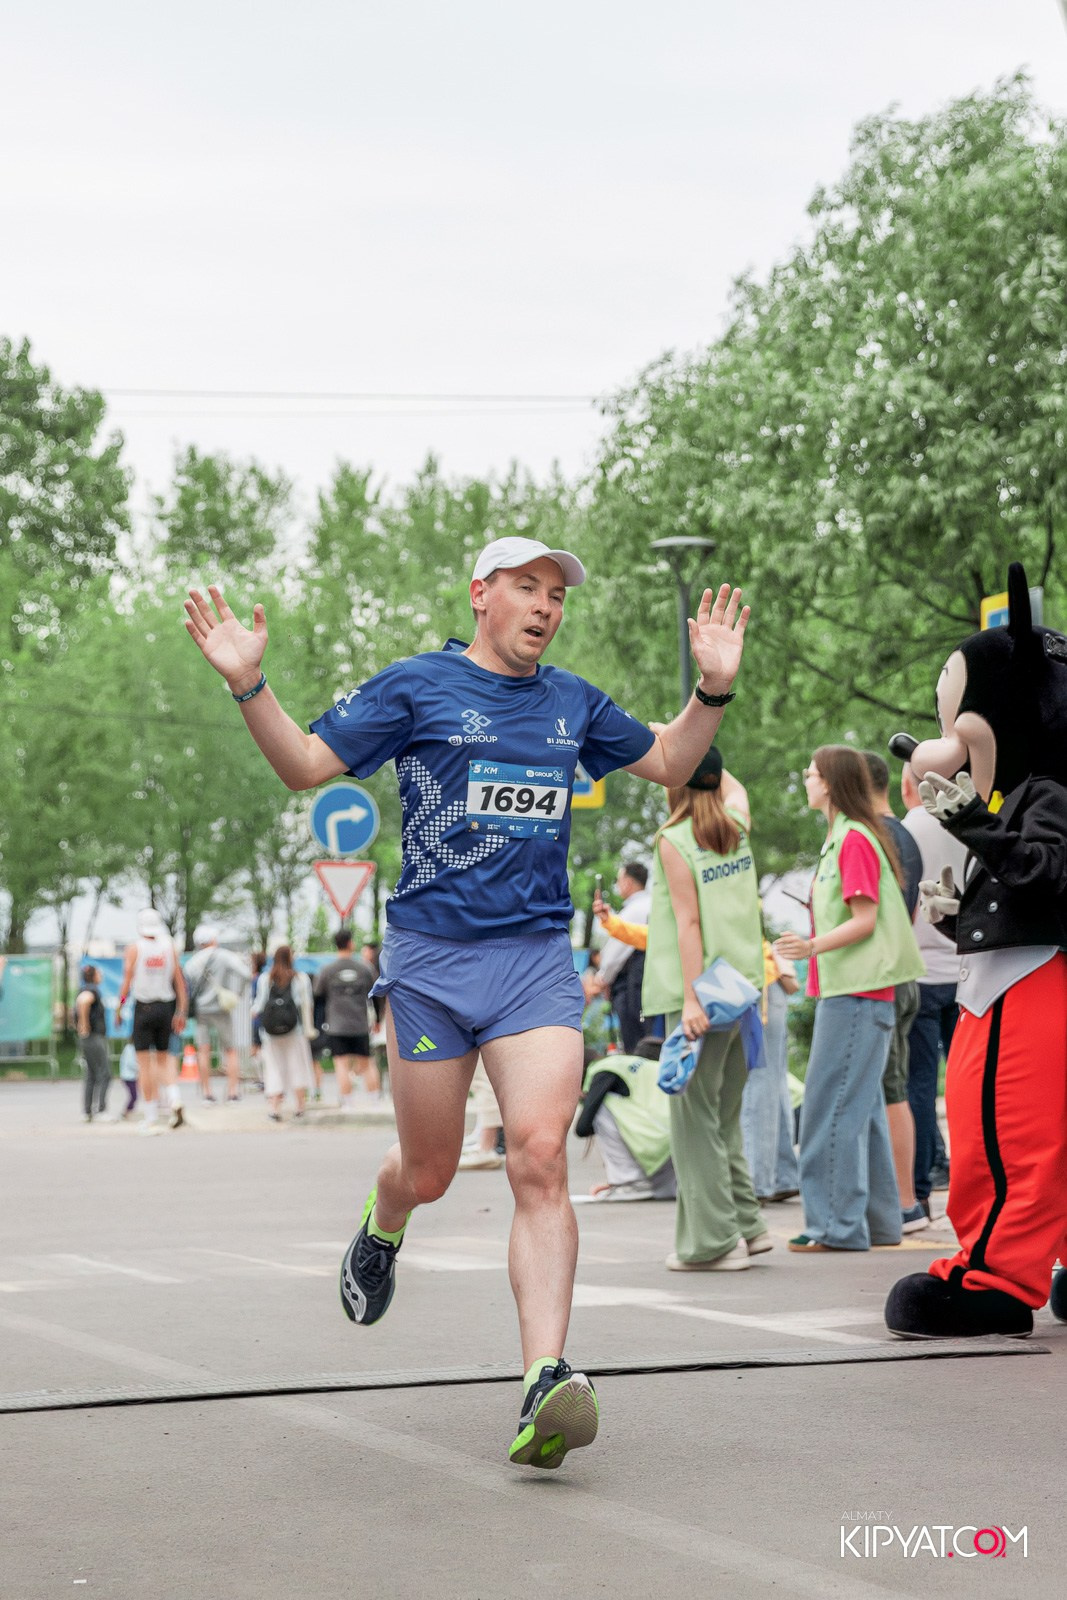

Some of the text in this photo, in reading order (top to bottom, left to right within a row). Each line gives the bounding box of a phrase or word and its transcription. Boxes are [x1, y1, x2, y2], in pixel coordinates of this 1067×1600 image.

[464, 735, 498, 744] GROUP
[473, 764, 499, 775] 5 KM
[480, 785, 558, 816] 1694
[701, 855, 752, 884] ВОЛОНТЕР
